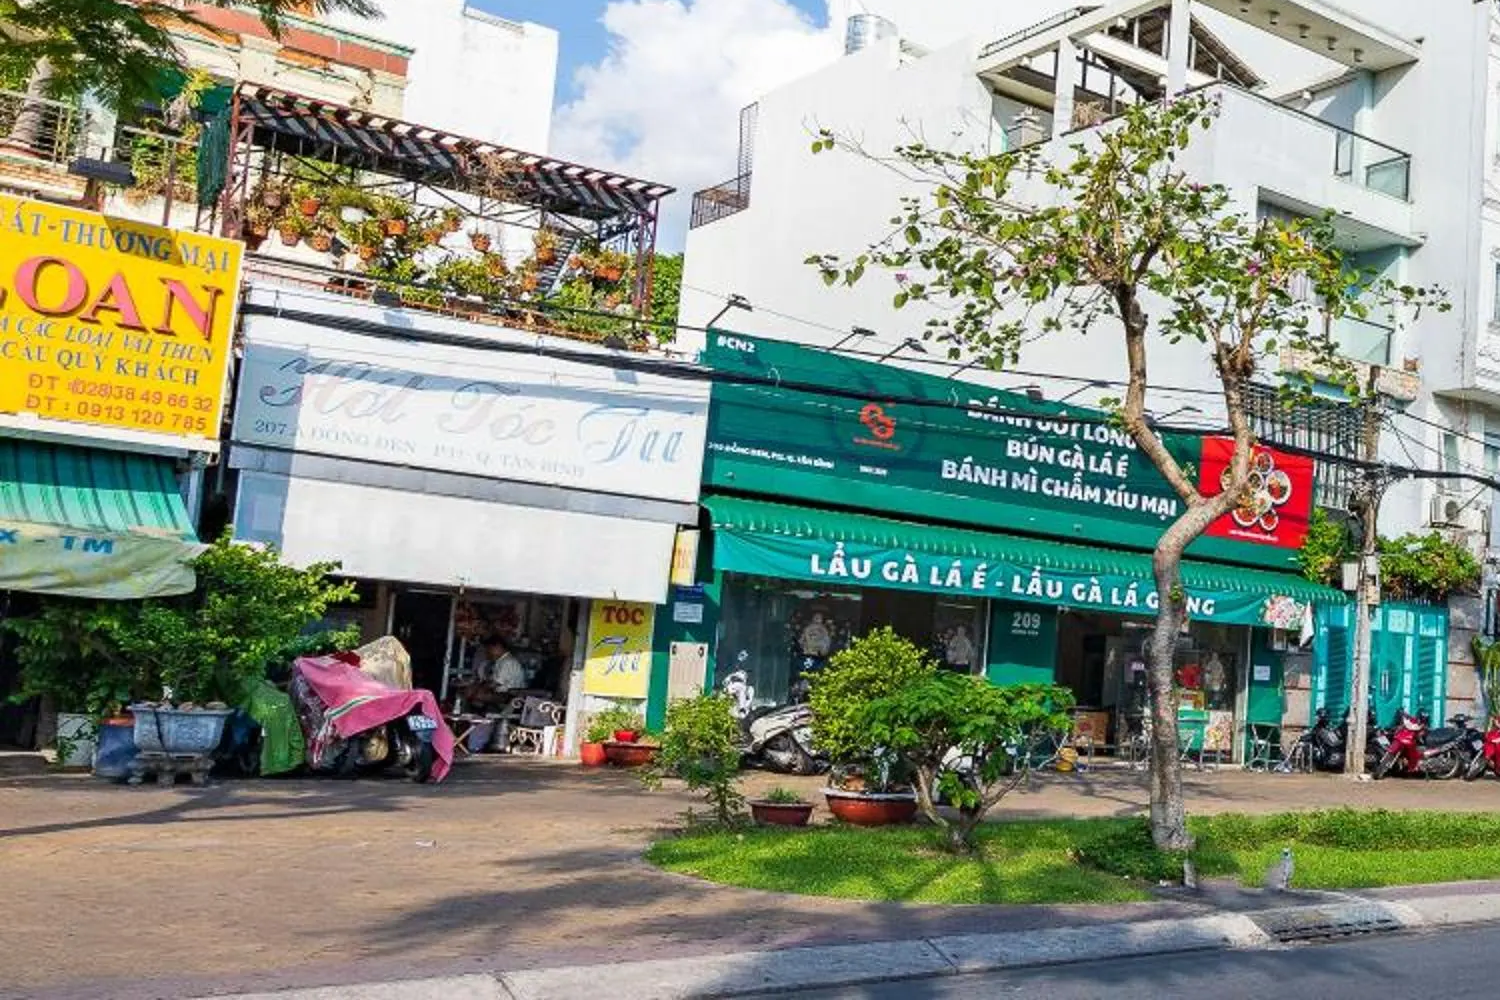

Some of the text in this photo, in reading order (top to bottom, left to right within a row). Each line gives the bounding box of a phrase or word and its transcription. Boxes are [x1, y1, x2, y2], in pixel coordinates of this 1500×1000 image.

[0, 255, 223, 342] OAN
[1006, 436, 1129, 479] BÚN GÀ LÁ É
[941, 457, 1008, 488] BÁNH
[1011, 466, 1038, 493] MÌ
[1104, 484, 1138, 510] XÍU
[1141, 496, 1178, 520] MẠI
[62, 535, 115, 555] TM
[810, 541, 872, 578] LẨU
[882, 554, 919, 583] GÀ
[930, 559, 963, 588] LÁ
[972, 563, 987, 589] É
[1011, 565, 1063, 599] LẨU
[1072, 577, 1103, 603] GÀ
[1111, 581, 1138, 607] LÁ
[602, 602, 645, 625] TÓC
[1011, 611, 1041, 629] 209
